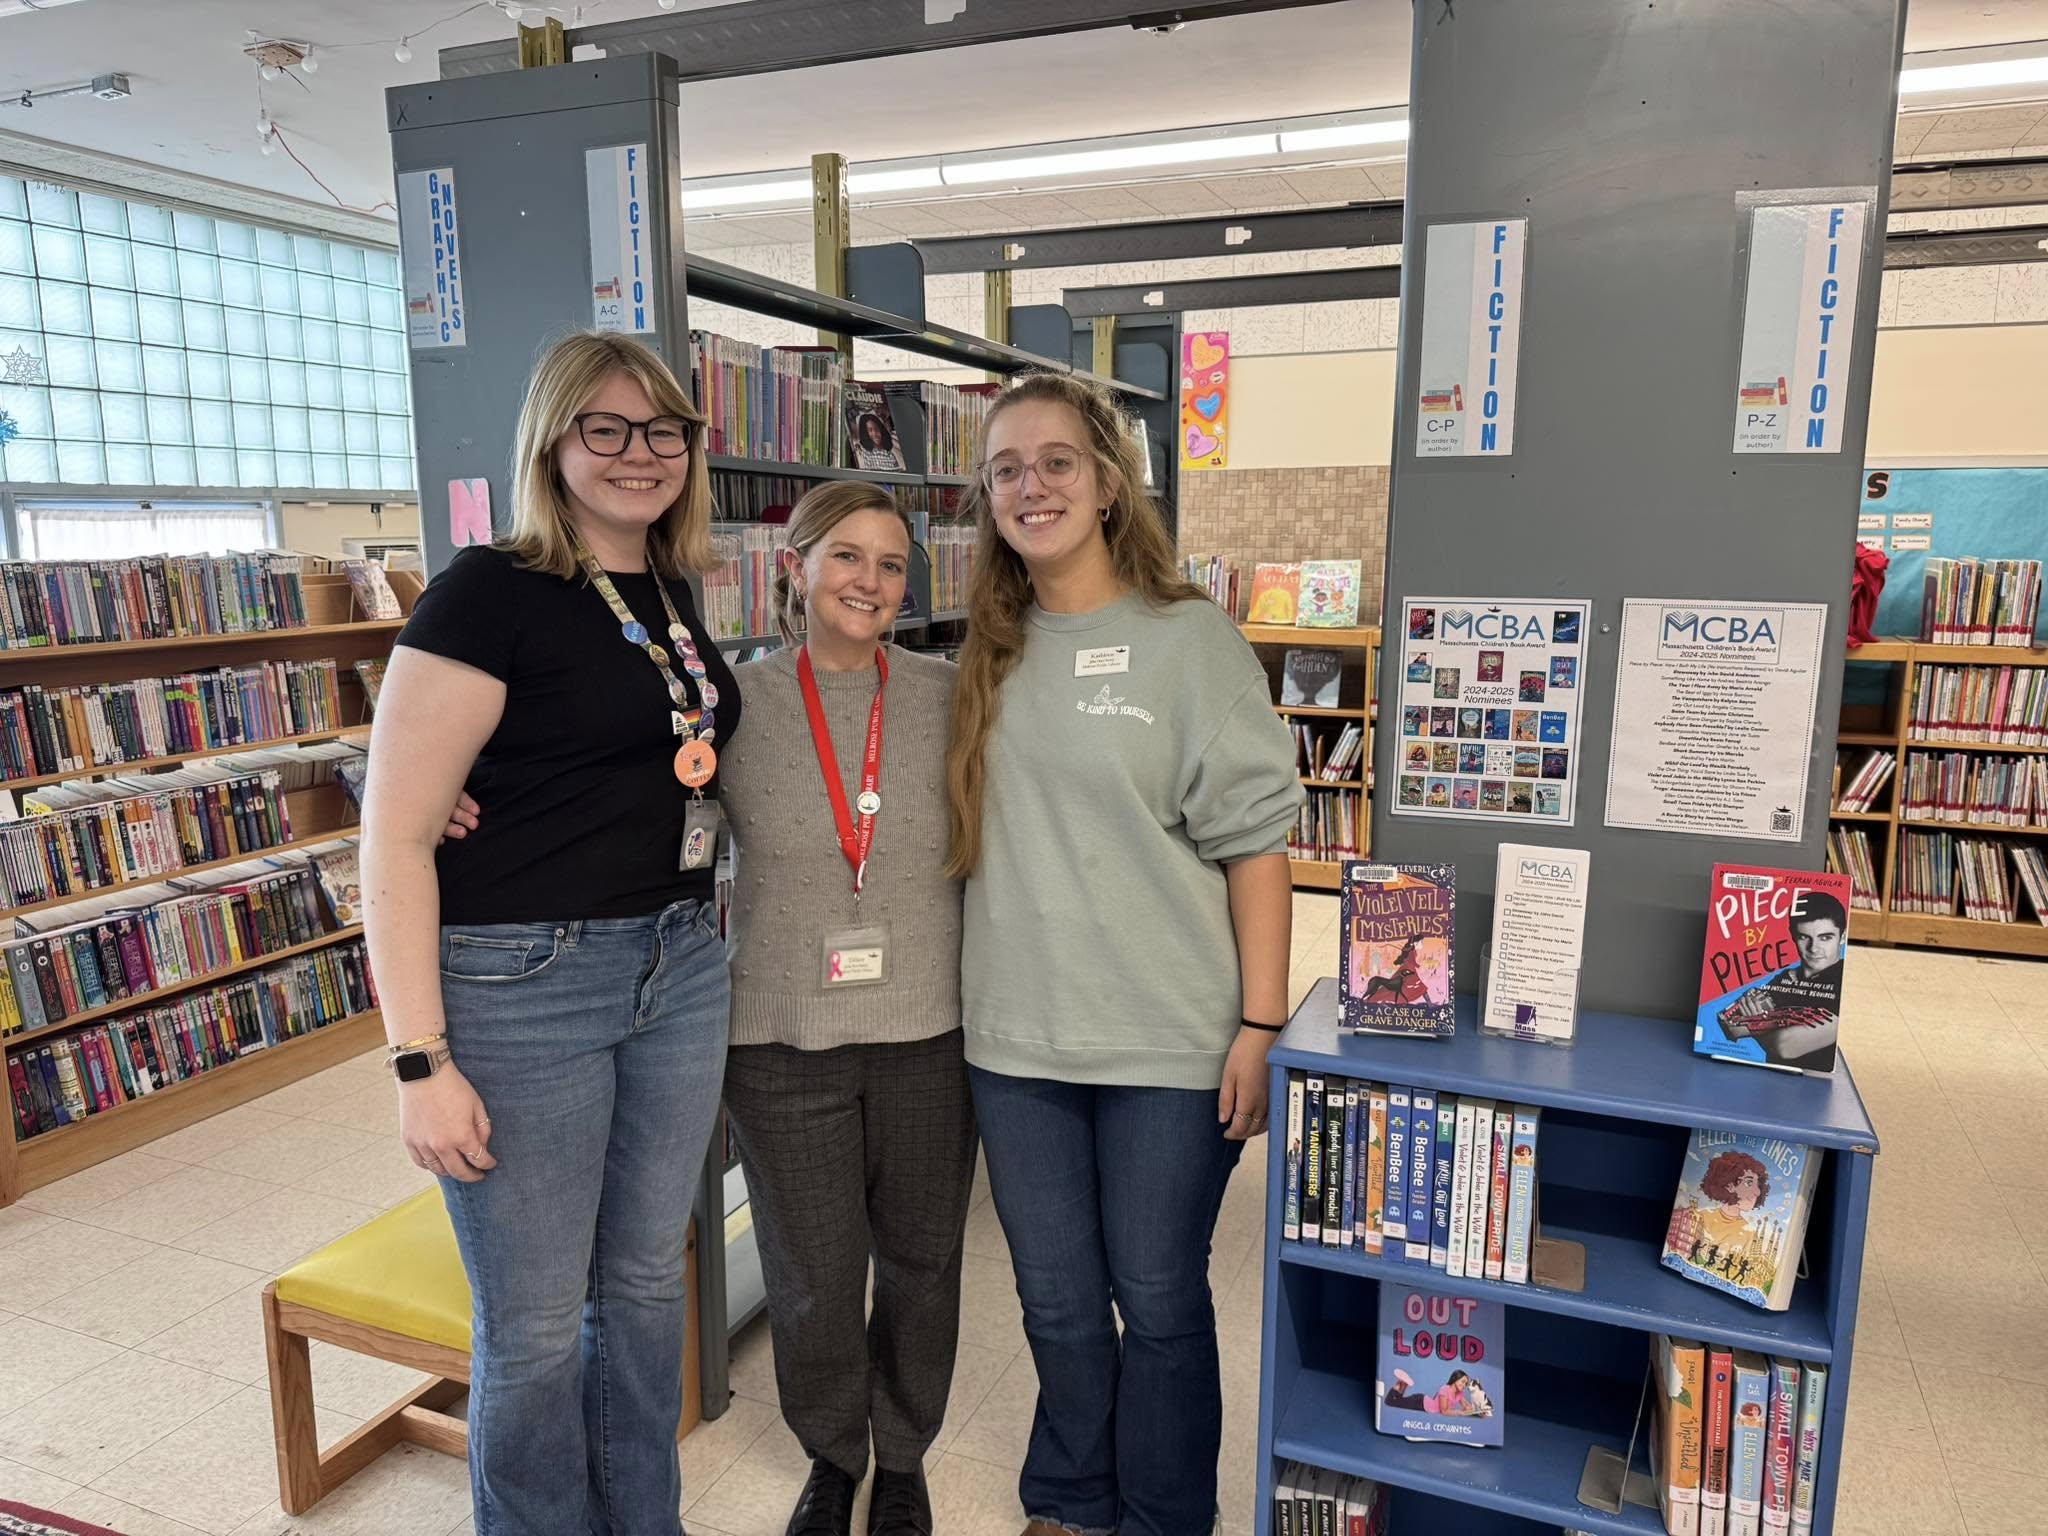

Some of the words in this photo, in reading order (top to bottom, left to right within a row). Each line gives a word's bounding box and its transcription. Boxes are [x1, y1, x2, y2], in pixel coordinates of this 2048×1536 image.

[628, 148, 644, 329] FICTION
[429, 173, 450, 342] GRAPHIC
[442, 184, 460, 329] NOVELS
[601, 305, 617, 315] A-C
[1481, 226, 1506, 450] FICTION
[1806, 208, 1843, 447] FICTION
[846, 392, 883, 404] CLAUDIE
[1427, 420, 1454, 432] C-P
[1747, 414, 1776, 427] P-Z
[1772, 433, 1780, 441] by
[1866, 471, 1890, 499] S
[448, 478, 492, 547] N
[1441, 609, 1545, 640] MCBA
[1663, 611, 1776, 645] MCBA
[1293, 662, 1329, 673] GARDEN
[1720, 652, 1755, 661] Nominees
[1463, 686, 1515, 695] 2024-2025
[1464, 695, 1512, 704] Nominees
[872, 709, 881, 732] PUBLIC
[1077, 700, 1086, 711] BE
[1087, 705, 1106, 715] KIND
[1107, 705, 1117, 715] TO
[1120, 705, 1155, 725] YOURSELF
[868, 732, 878, 763] MELROSE
[323, 853, 353, 870] Juana
[1396, 864, 1431, 874] CLEVERLY
[1521, 861, 1572, 879] MCBA
[1784, 876, 1812, 885] FERRAN
[1815, 878, 1843, 888] AGUILAR
[1355, 890, 1404, 915] VIOLET
[1406, 888, 1443, 912] VEIL
[1715, 888, 1811, 939] PIECE
[1360, 914, 1443, 940] MYSTERIES
[1744, 925, 1767, 946] BY
[1710, 939, 1790, 993] PIECE
[1360, 1016, 1392, 1025] GRAVE
[1395, 1016, 1437, 1028] DANGER
[1375, 1007, 1382, 1015] A
[1384, 1007, 1410, 1016] CASE
[1412, 1009, 1425, 1017] OF
[1514, 1024, 1536, 1032] Mass
[1311, 1117, 1319, 1128] THE
[1328, 1120, 1341, 1153] Anybody
[1308, 1129, 1320, 1197] VANQUISHERS
[1329, 1156, 1339, 1169] Here
[1389, 1133, 1403, 1183] BenBee
[1413, 1136, 1428, 1186] BenBee
[1457, 1144, 1468, 1165] Violet
[1476, 1144, 1486, 1165] Violet
[1495, 1144, 1506, 1181] SMALL
[1699, 1128, 1736, 1148] ELLEN
[1744, 1136, 1757, 1148] THE
[1761, 1139, 1798, 1176] LINES
[1330, 1170, 1338, 1185] Seen
[1435, 1159, 1449, 1191] NIKHIL
[1457, 1165, 1466, 1174] &
[1476, 1165, 1484, 1174] &
[1456, 1173, 1467, 1192] Jobie
[1474, 1173, 1485, 1192] Jobie
[1515, 1170, 1528, 1197] ELLEN
[1327, 1187, 1339, 1223] Frenchie?
[1435, 1191, 1447, 1207] OUT
[1454, 1202, 1465, 1214] the
[1473, 1203, 1484, 1215] the
[1494, 1183, 1504, 1219] TOWN
[1434, 1208, 1447, 1227] LOUD
[1453, 1216, 1464, 1235] Wild
[1471, 1216, 1482, 1235] Wild
[1491, 1219, 1502, 1253] PRIDE
[1511, 1234, 1525, 1262] LINES
[1405, 1292, 1478, 1328] OUT
[1393, 1328, 1484, 1363] LOUD
[1687, 1360, 1696, 1385] FARUQI
[1403, 1419, 1430, 1430] ANGELA
[1433, 1423, 1472, 1435] CERVANTES
[1715, 1401, 1723, 1445] UNFORGETTABLE
[1776, 1391, 1793, 1440] SMALL
[1677, 1420, 1698, 1474] Unsettled
[1744, 1431, 1757, 1459] ELLEN
[1801, 1430, 1818, 1453] WAYS
[1774, 1445, 1789, 1488] TOWN
[1800, 1459, 1812, 1482] MAKE
